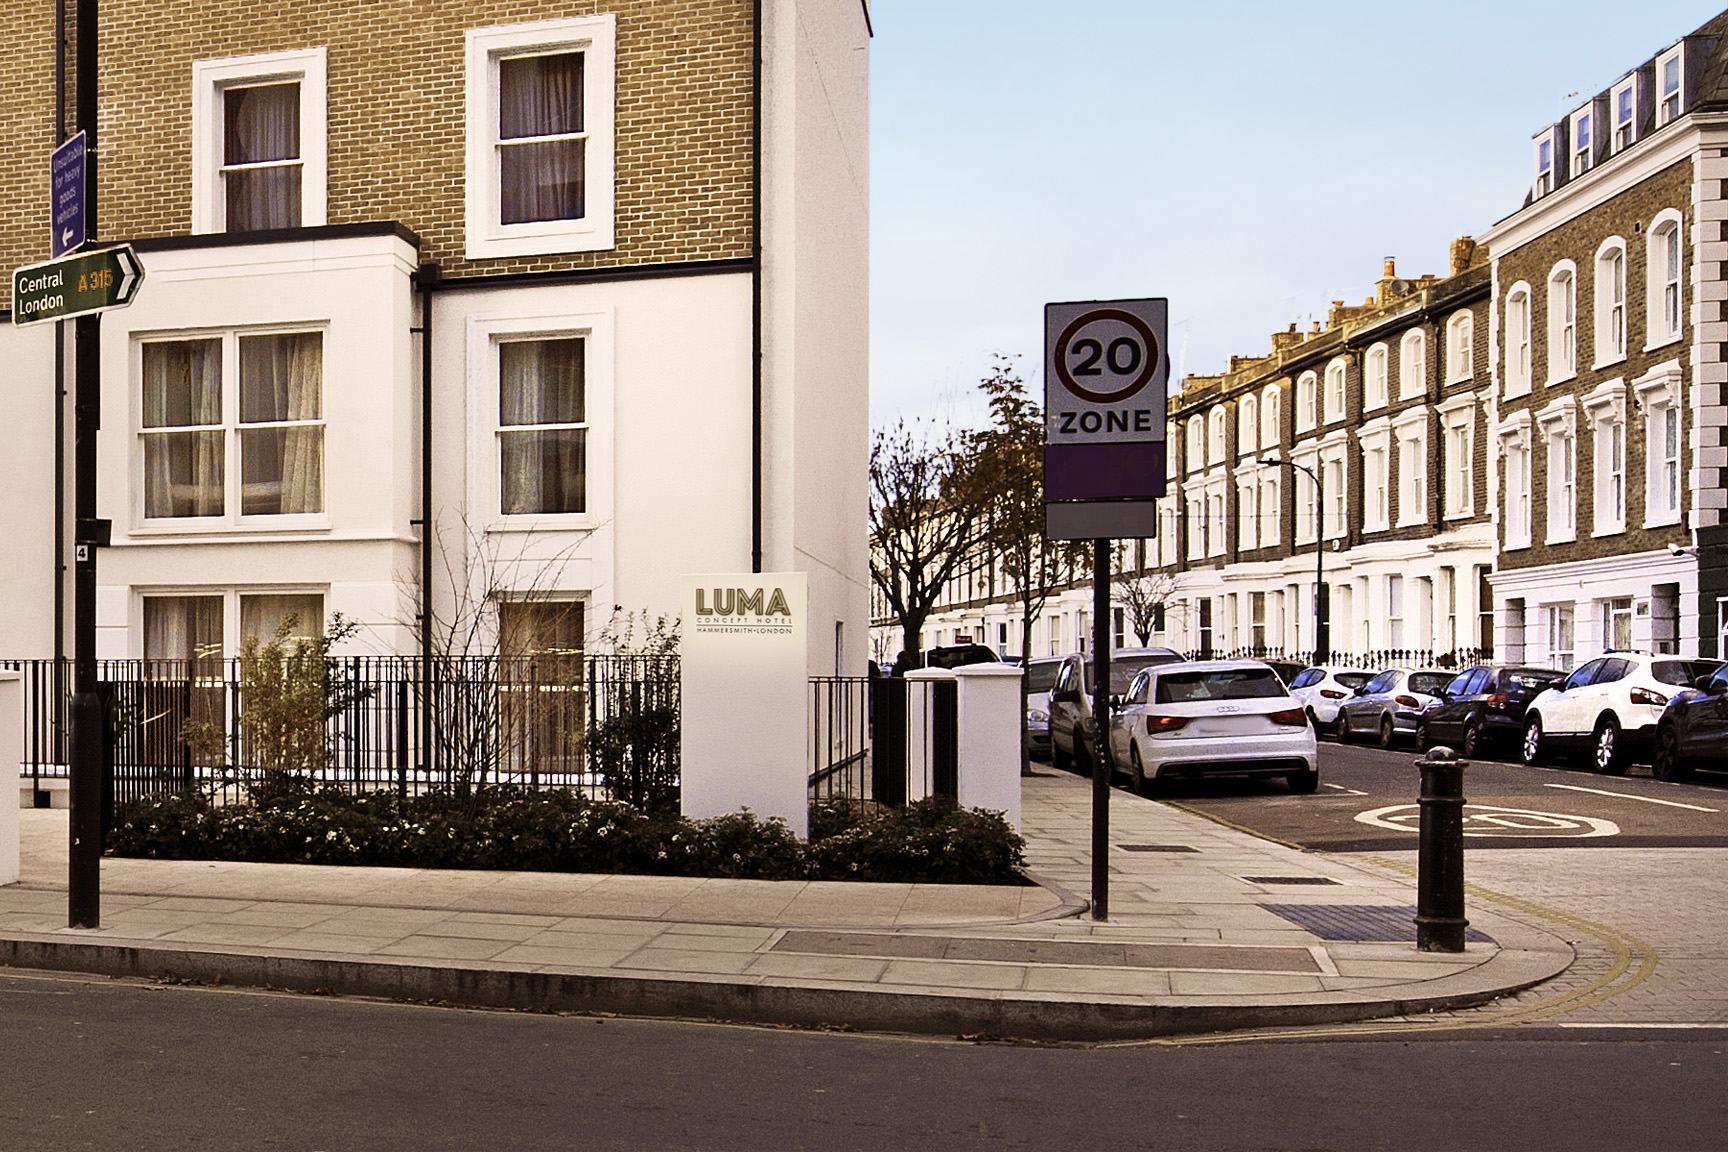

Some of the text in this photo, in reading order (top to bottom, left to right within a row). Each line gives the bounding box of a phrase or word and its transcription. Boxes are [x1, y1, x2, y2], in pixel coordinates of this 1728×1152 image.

[53, 143, 83, 173] Unsuitable
[55, 164, 80, 190] for heavy
[59, 185, 76, 209] goods
[57, 202, 79, 224] vehicles
[19, 269, 63, 294] Central
[19, 293, 63, 315] London
[1071, 336, 1141, 376] 20
[1059, 409, 1152, 434] ZONE
[77, 547, 86, 558] 4
[696, 588, 791, 616] LUMA
